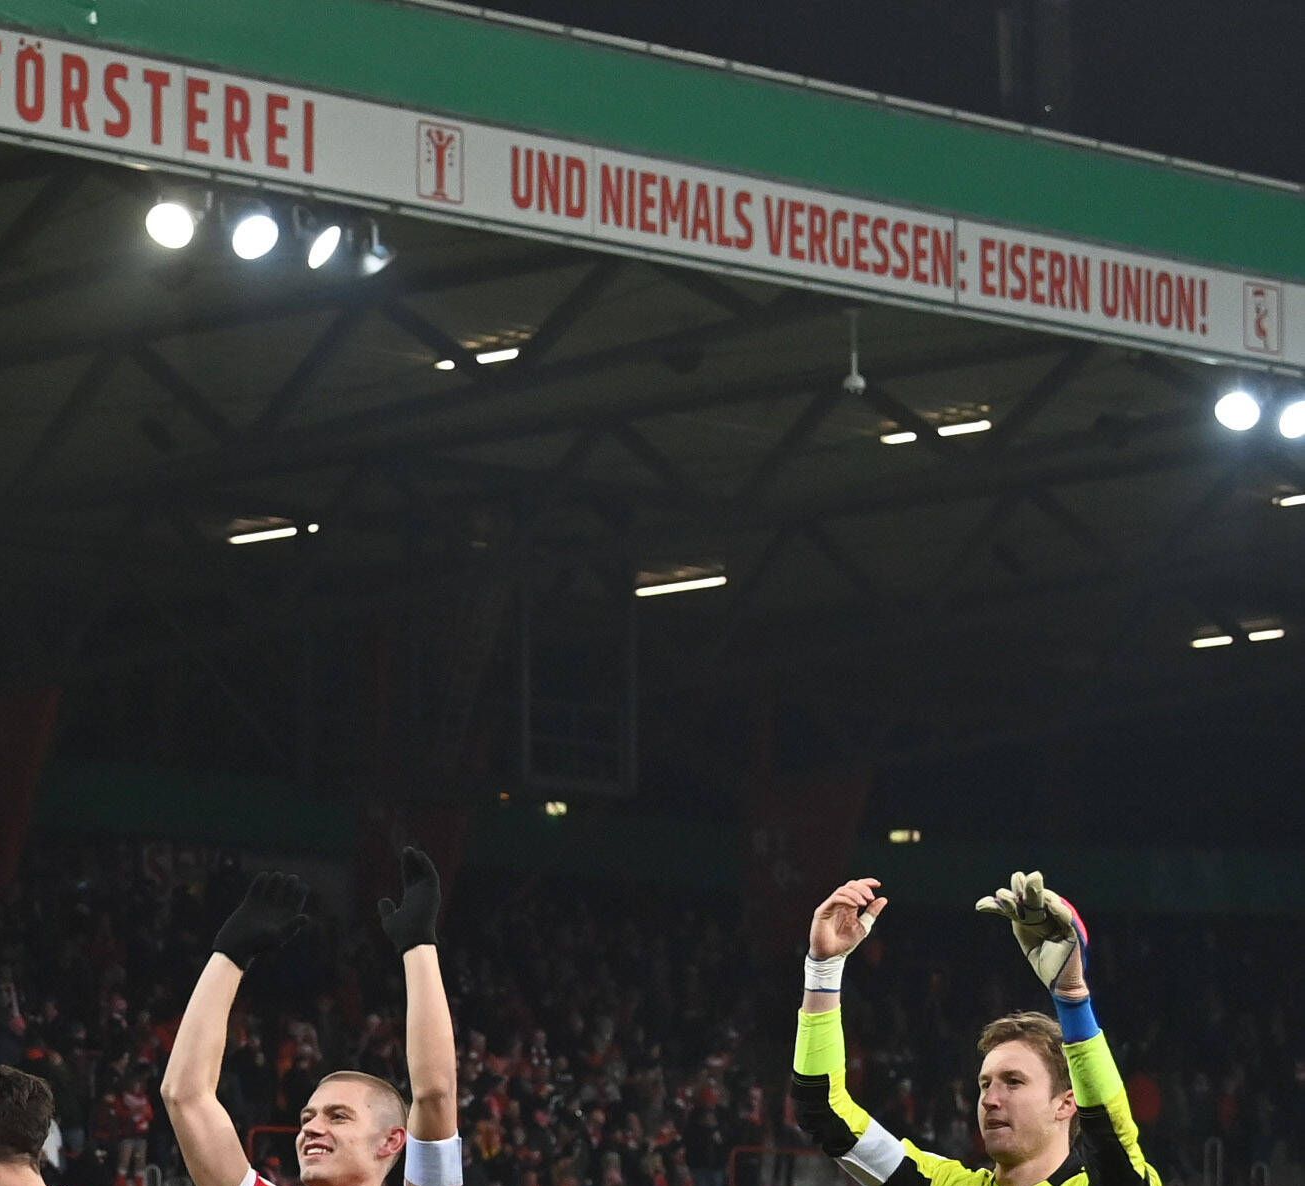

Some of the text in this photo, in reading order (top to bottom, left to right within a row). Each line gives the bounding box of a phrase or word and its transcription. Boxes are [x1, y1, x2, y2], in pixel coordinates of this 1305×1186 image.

[509, 145, 587, 219] UND
[600, 162, 753, 250] NIEMALS
[978, 238, 1091, 314] EISERN
[1098, 262, 1210, 337] UNION!
